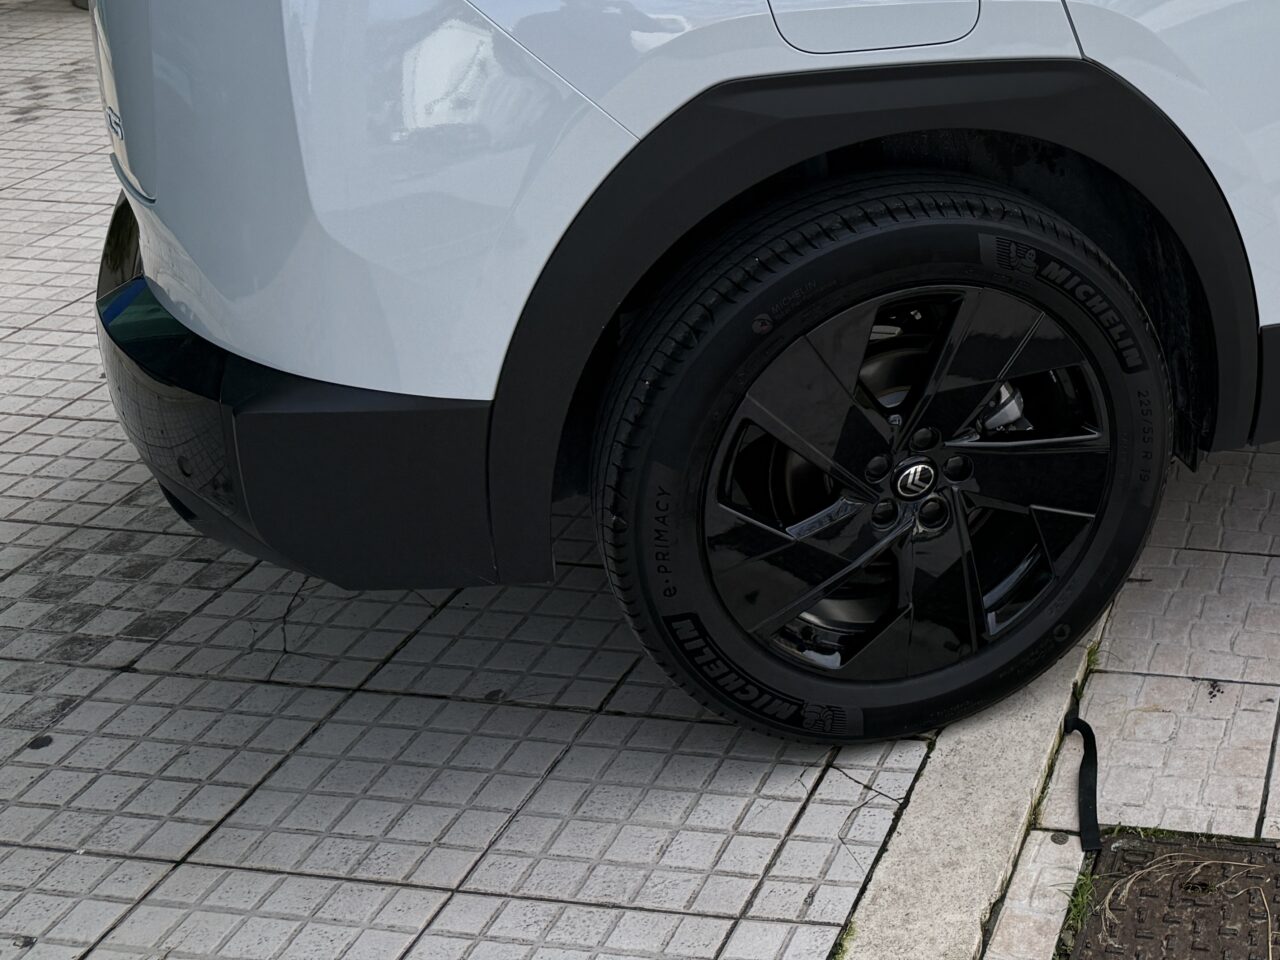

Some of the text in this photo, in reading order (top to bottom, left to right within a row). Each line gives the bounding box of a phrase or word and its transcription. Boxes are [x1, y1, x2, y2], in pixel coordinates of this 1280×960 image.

[1040, 260, 1143, 368] MICHELIN
[1137, 390, 1153, 444] 225/55
[671, 618, 799, 721] MICHELIN
